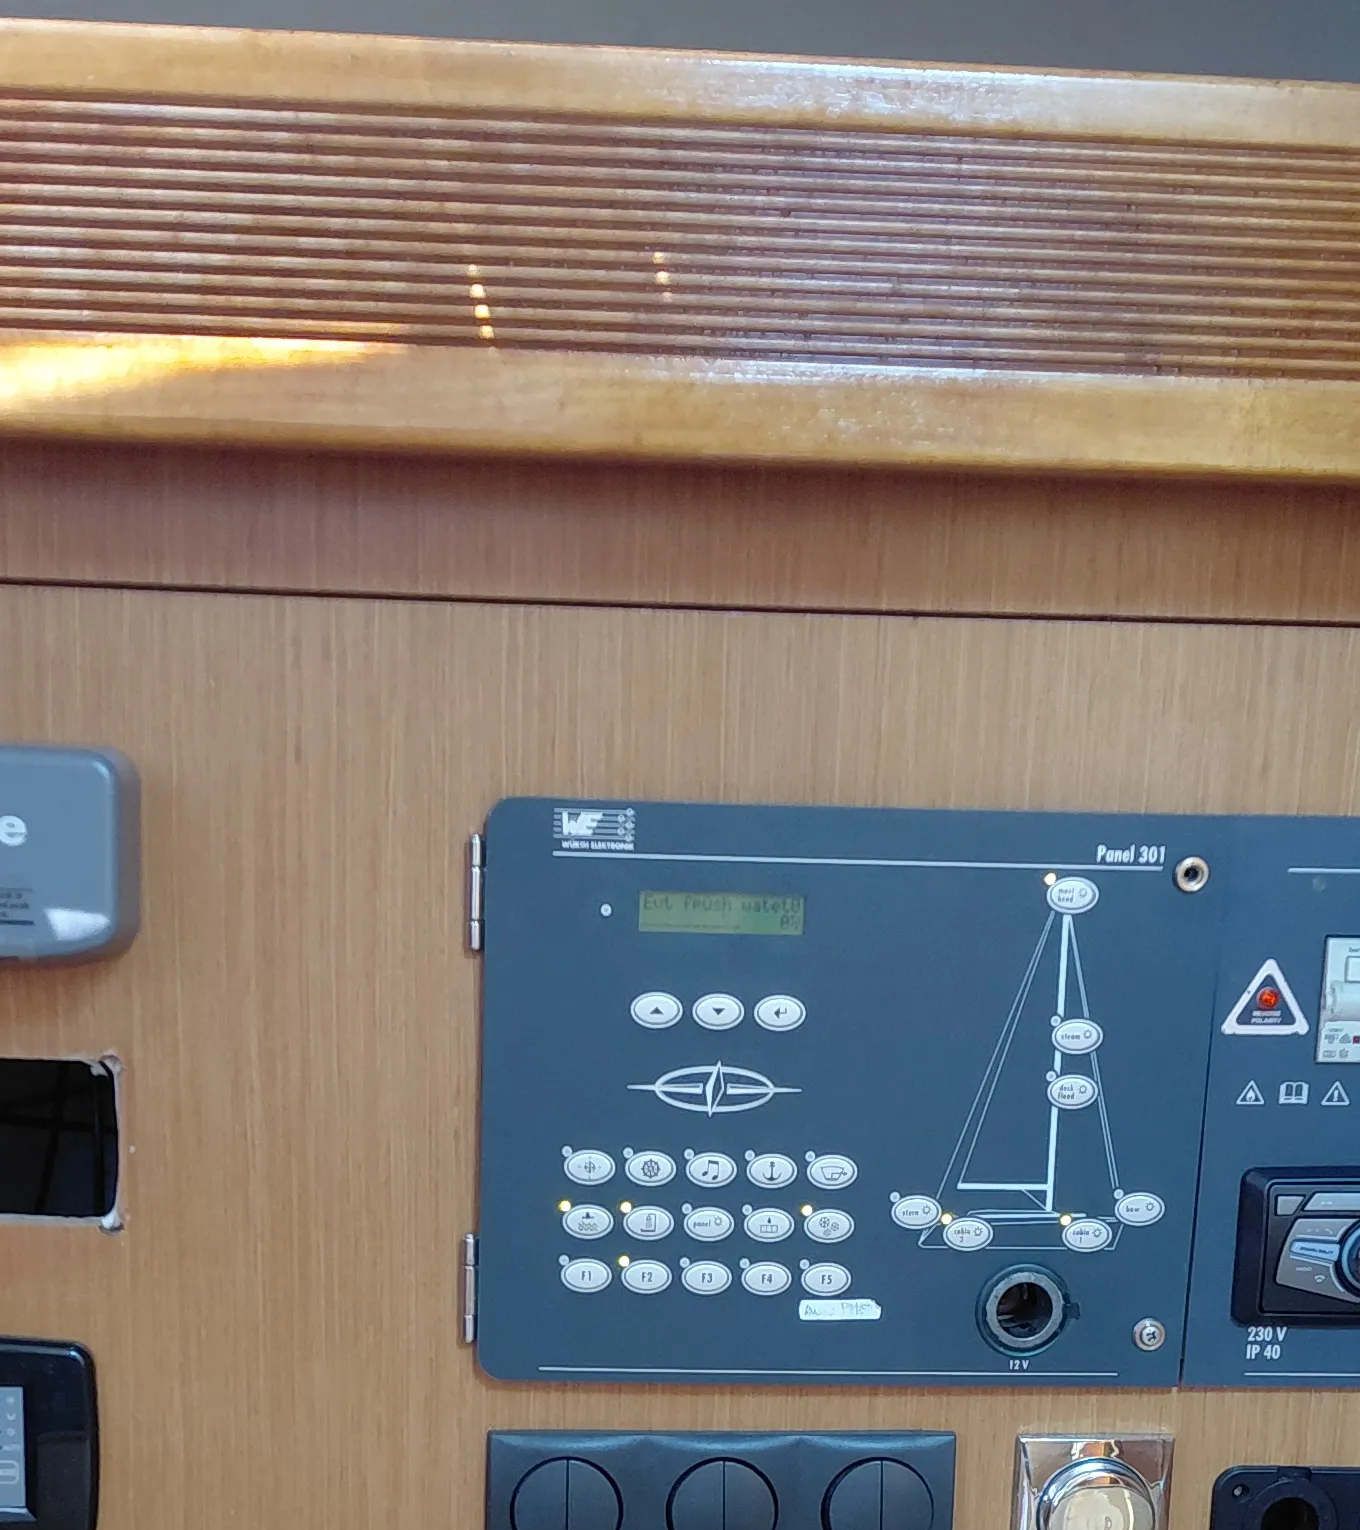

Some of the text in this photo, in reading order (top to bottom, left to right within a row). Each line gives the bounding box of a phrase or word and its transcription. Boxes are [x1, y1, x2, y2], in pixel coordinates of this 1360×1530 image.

[1096, 844, 1166, 864] Panel 301
[581, 1270, 592, 1281] F1
[641, 1271, 653, 1282] F2
[701, 1273, 713, 1284] F3
[761, 1273, 773, 1284] F4
[821, 1274, 833, 1285] F5
[1247, 1326, 1288, 1342] 230 V
[1246, 1343, 1281, 1360] IP 40
